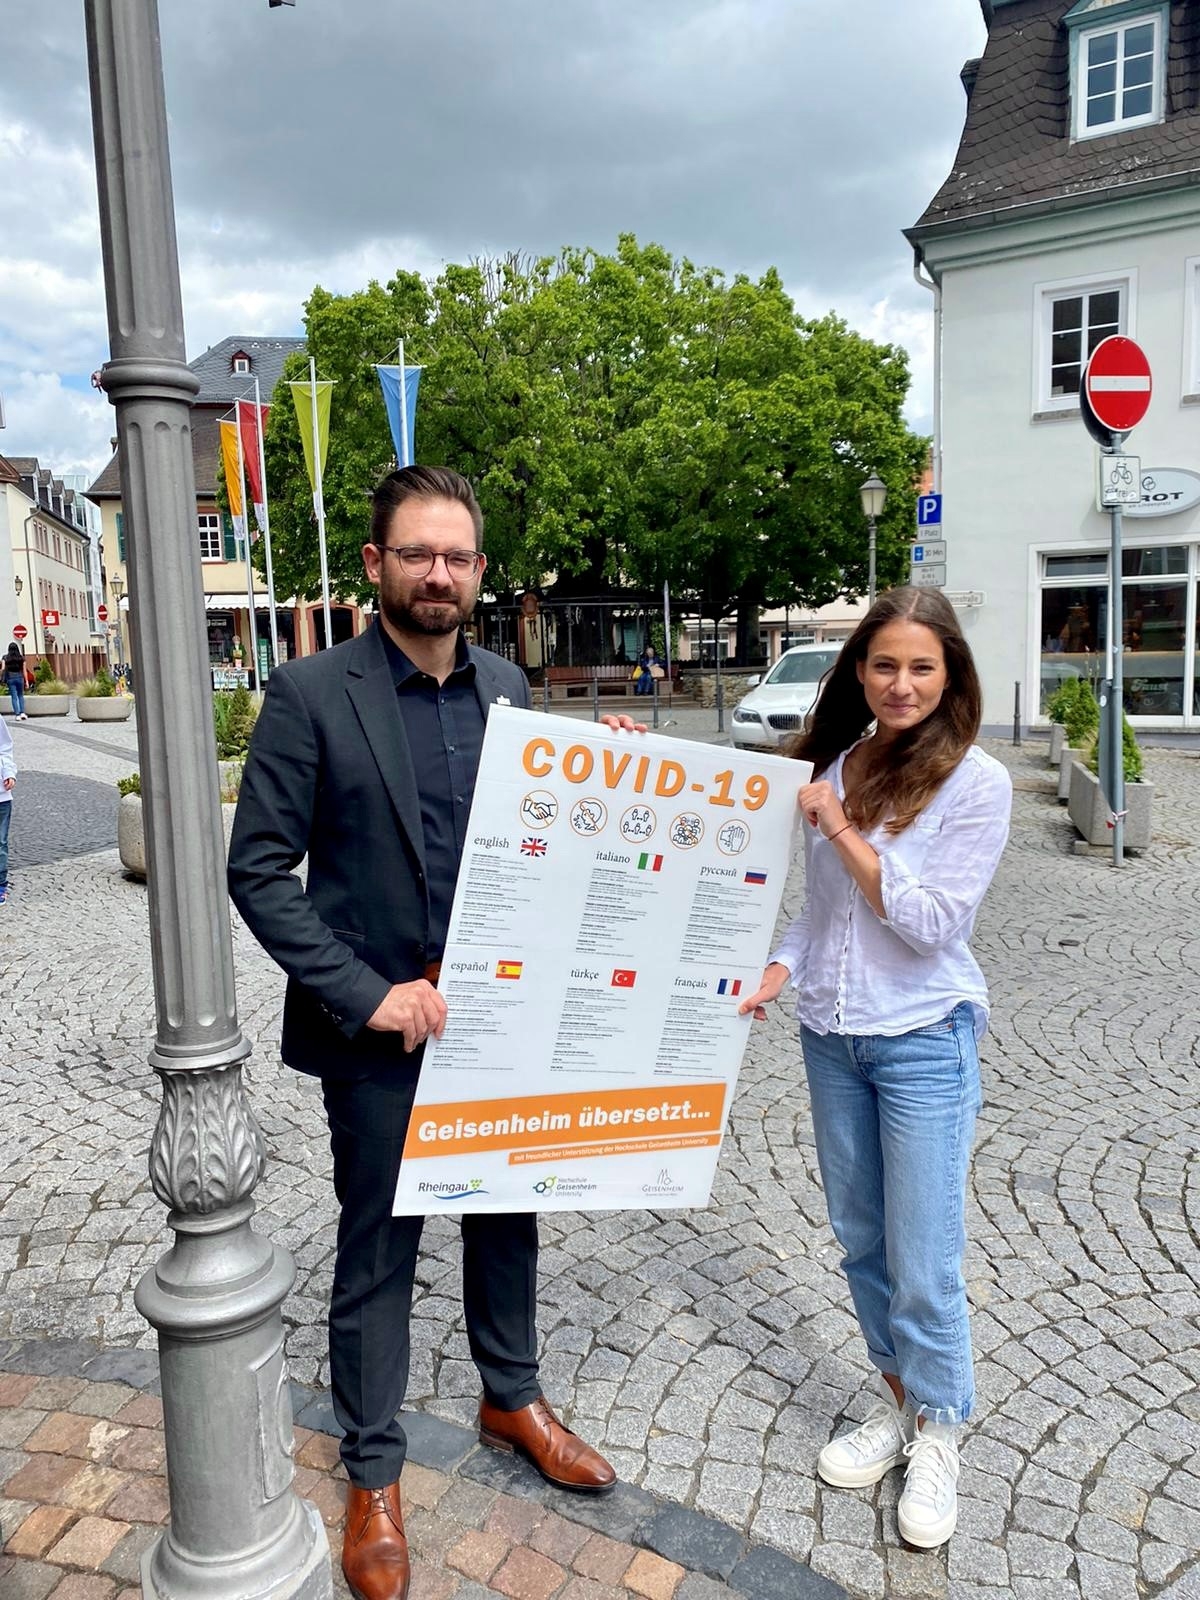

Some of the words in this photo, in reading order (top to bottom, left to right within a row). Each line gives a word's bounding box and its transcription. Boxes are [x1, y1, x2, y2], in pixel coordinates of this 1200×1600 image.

[1140, 491, 1184, 502] ROT
[923, 499, 937, 522] P
[522, 737, 770, 811] COVID-19
[474, 836, 510, 849] english
[596, 850, 631, 864] italiano
[700, 866, 737, 877] русский
[450, 961, 488, 973] español
[570, 968, 600, 981] türkçe
[674, 976, 708, 989] français
[418, 1111, 571, 1142] Geisenheim
[578, 1100, 711, 1127] übersetzt...
[525, 1149, 562, 1161] freundlicher
[604, 1145, 614, 1153] der
[614, 1142, 648, 1152] Hochschule
[648, 1139, 681, 1150] Geisenheim
[681, 1137, 709, 1147] University
[418, 1181, 469, 1194] Rheingau
[556, 1183, 597, 1191] Geisenheim
[641, 1184, 684, 1193] GEISENHEIM
